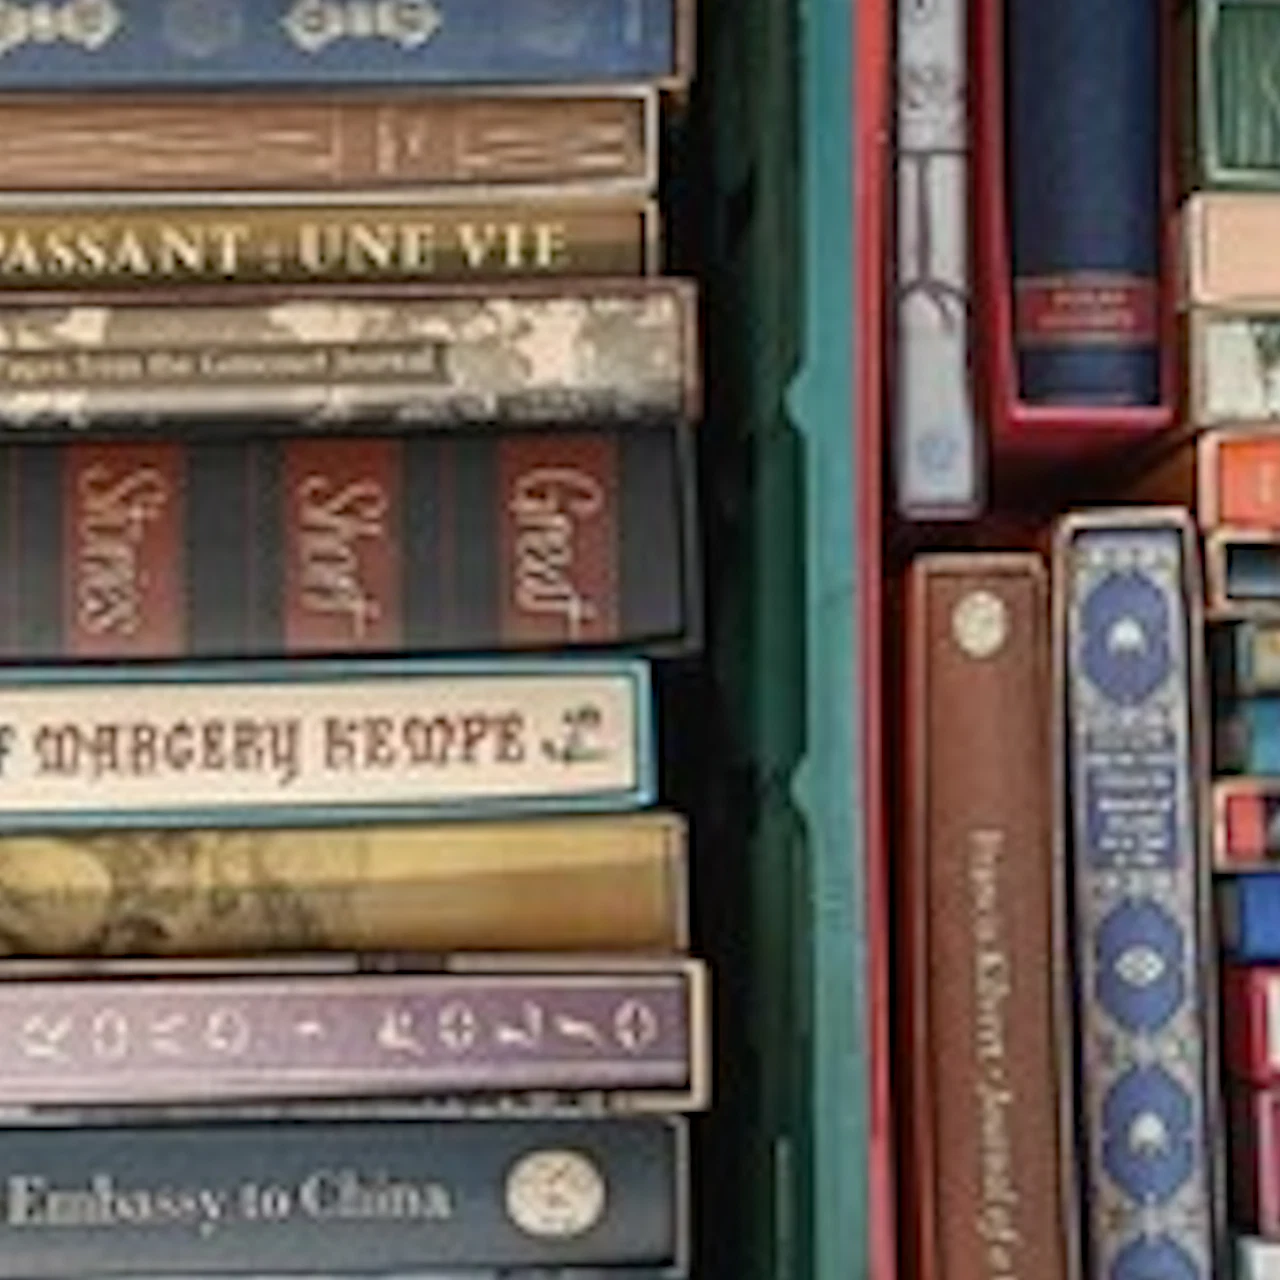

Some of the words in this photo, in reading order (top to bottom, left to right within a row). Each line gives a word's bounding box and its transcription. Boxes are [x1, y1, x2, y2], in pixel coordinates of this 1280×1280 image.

[303, 221, 437, 272] UNE
[458, 220, 570, 270] VIE
[292, 472, 388, 652] Short
[33, 720, 301, 787] MARGERY
[321, 712, 527, 771] KEMPE
[7, 1176, 222, 1236] Embassy
[238, 1174, 289, 1227] to
[299, 1169, 453, 1225] China
